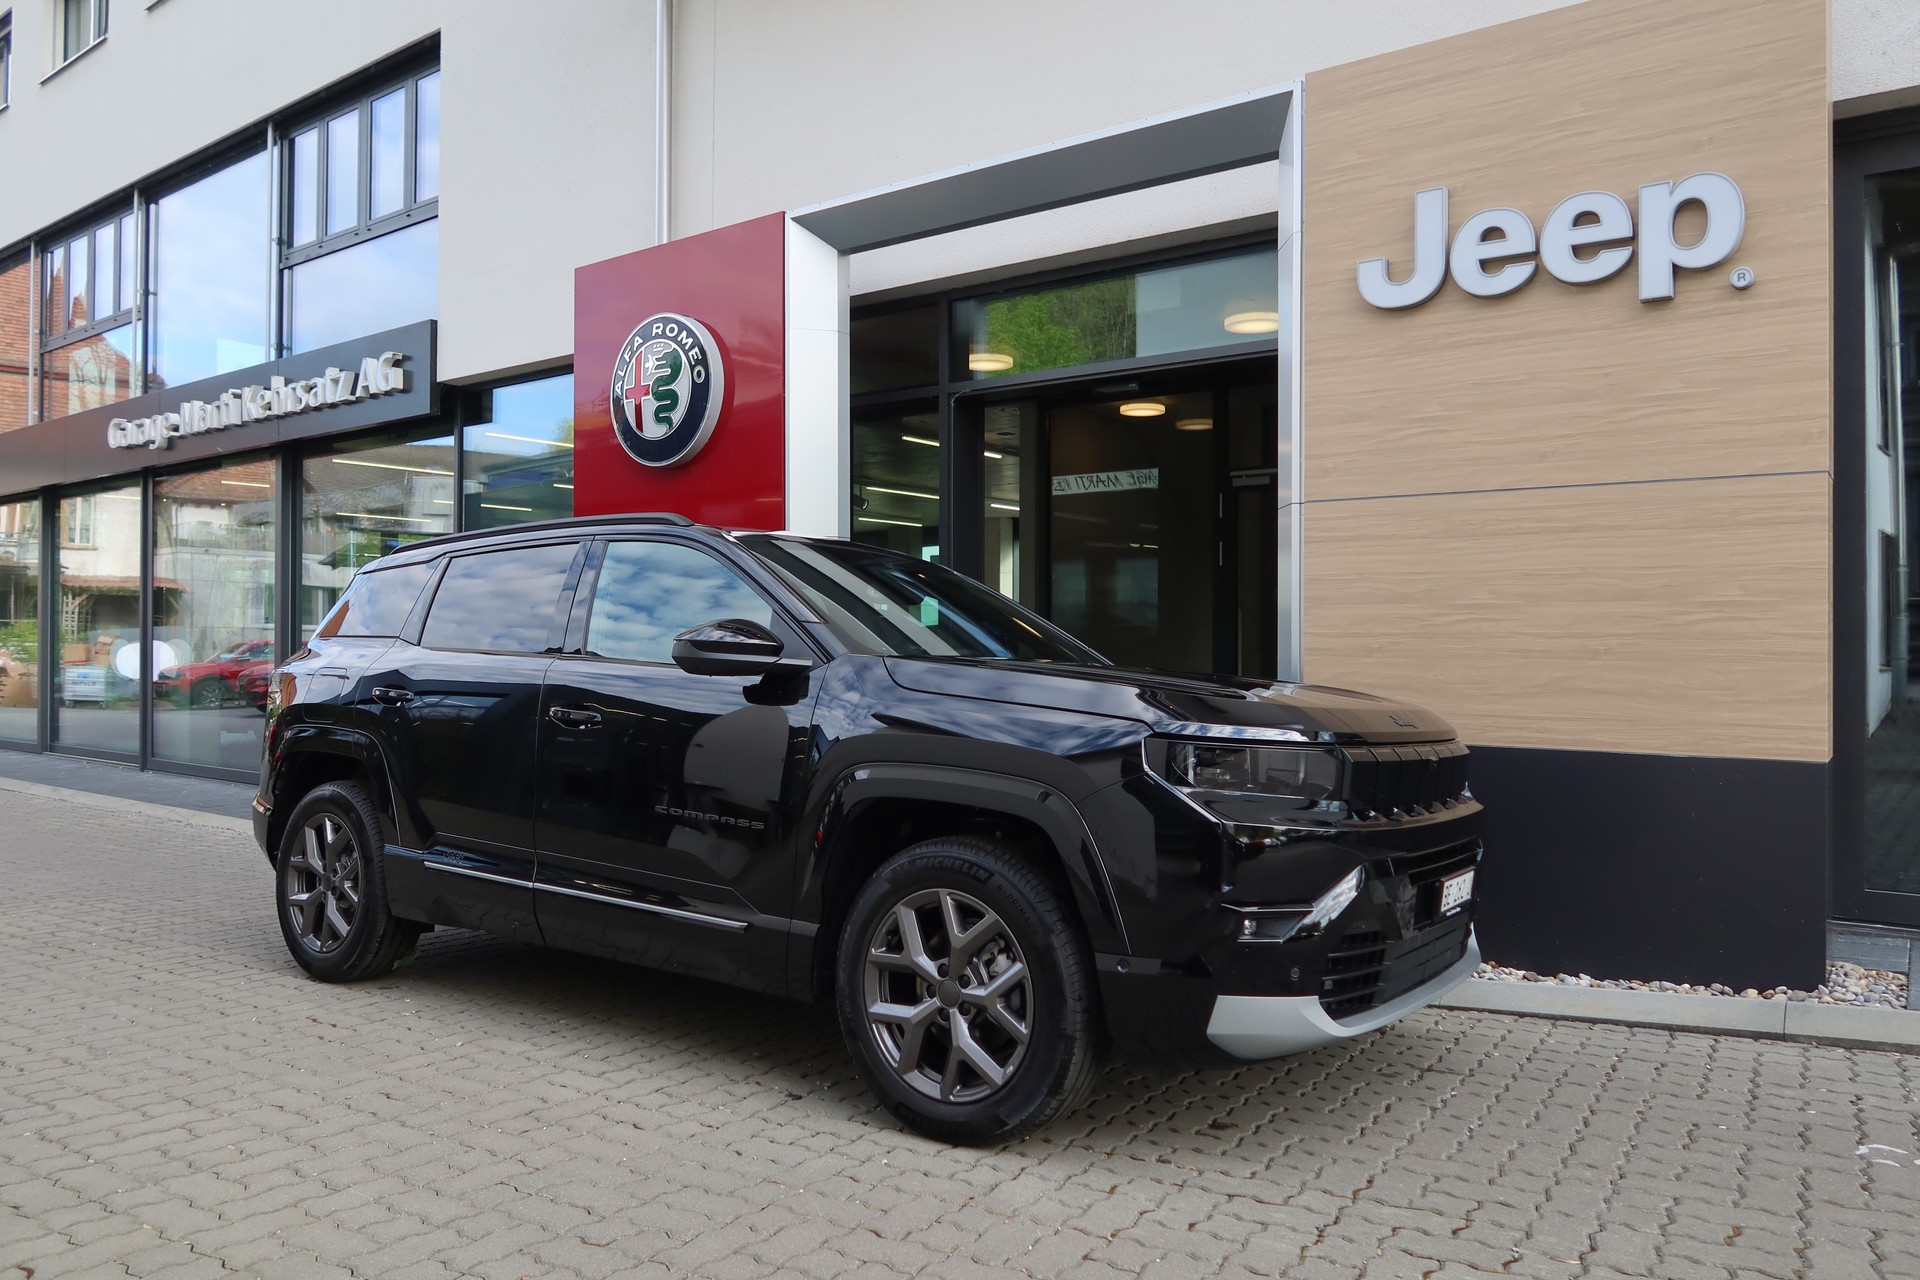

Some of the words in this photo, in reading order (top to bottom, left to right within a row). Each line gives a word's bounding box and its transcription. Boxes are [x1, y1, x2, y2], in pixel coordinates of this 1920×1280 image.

[1356, 171, 1746, 311] Jeep
[615, 335, 644, 396] ALFA
[651, 322, 706, 384] ROMEO
[108, 412, 180, 450] Garage
[180, 388, 242, 435] Marti
[241, 366, 357, 421] Kehrsatz
[356, 351, 404, 399] AG
[654, 805, 765, 829] COMPASS
[914, 857, 991, 882] MICHELIN
